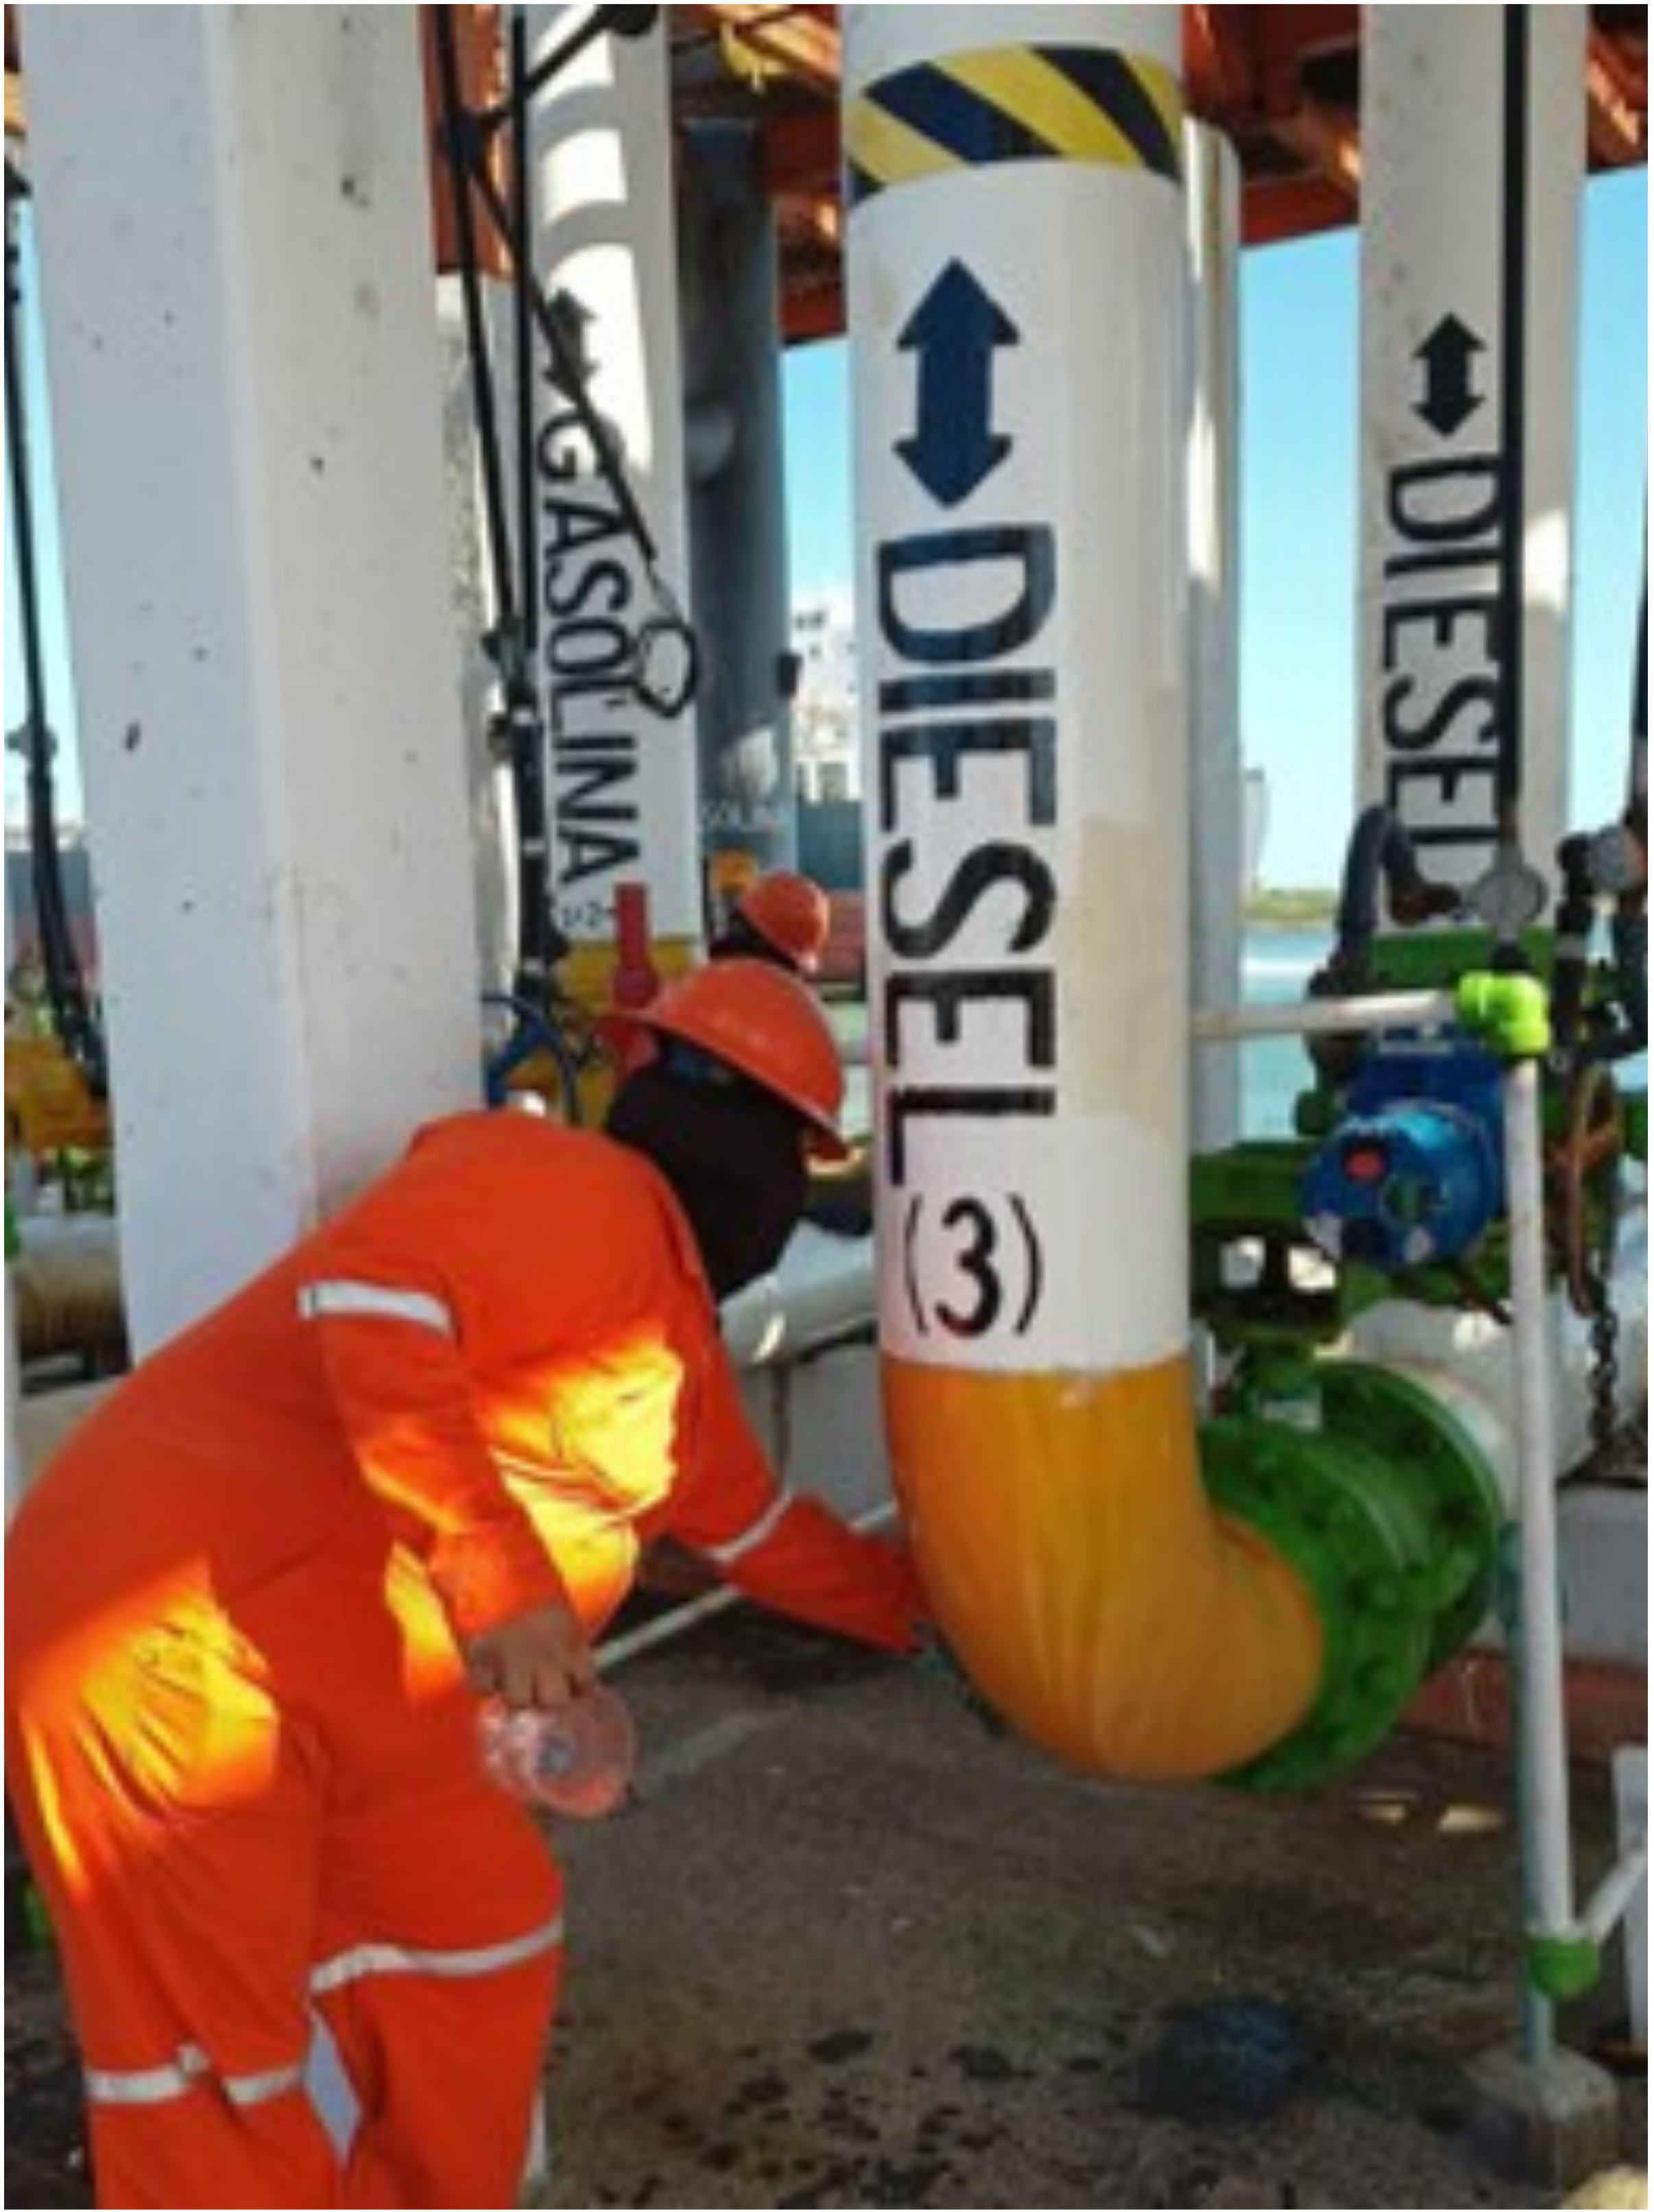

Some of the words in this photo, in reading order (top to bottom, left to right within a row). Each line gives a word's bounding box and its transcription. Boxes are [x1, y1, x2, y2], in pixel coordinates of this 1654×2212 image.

[536, 414, 640, 883] GASOLINA
[878, 523, 1057, 1186] DIESEL
[904, 1193, 1041, 1336] (3)
